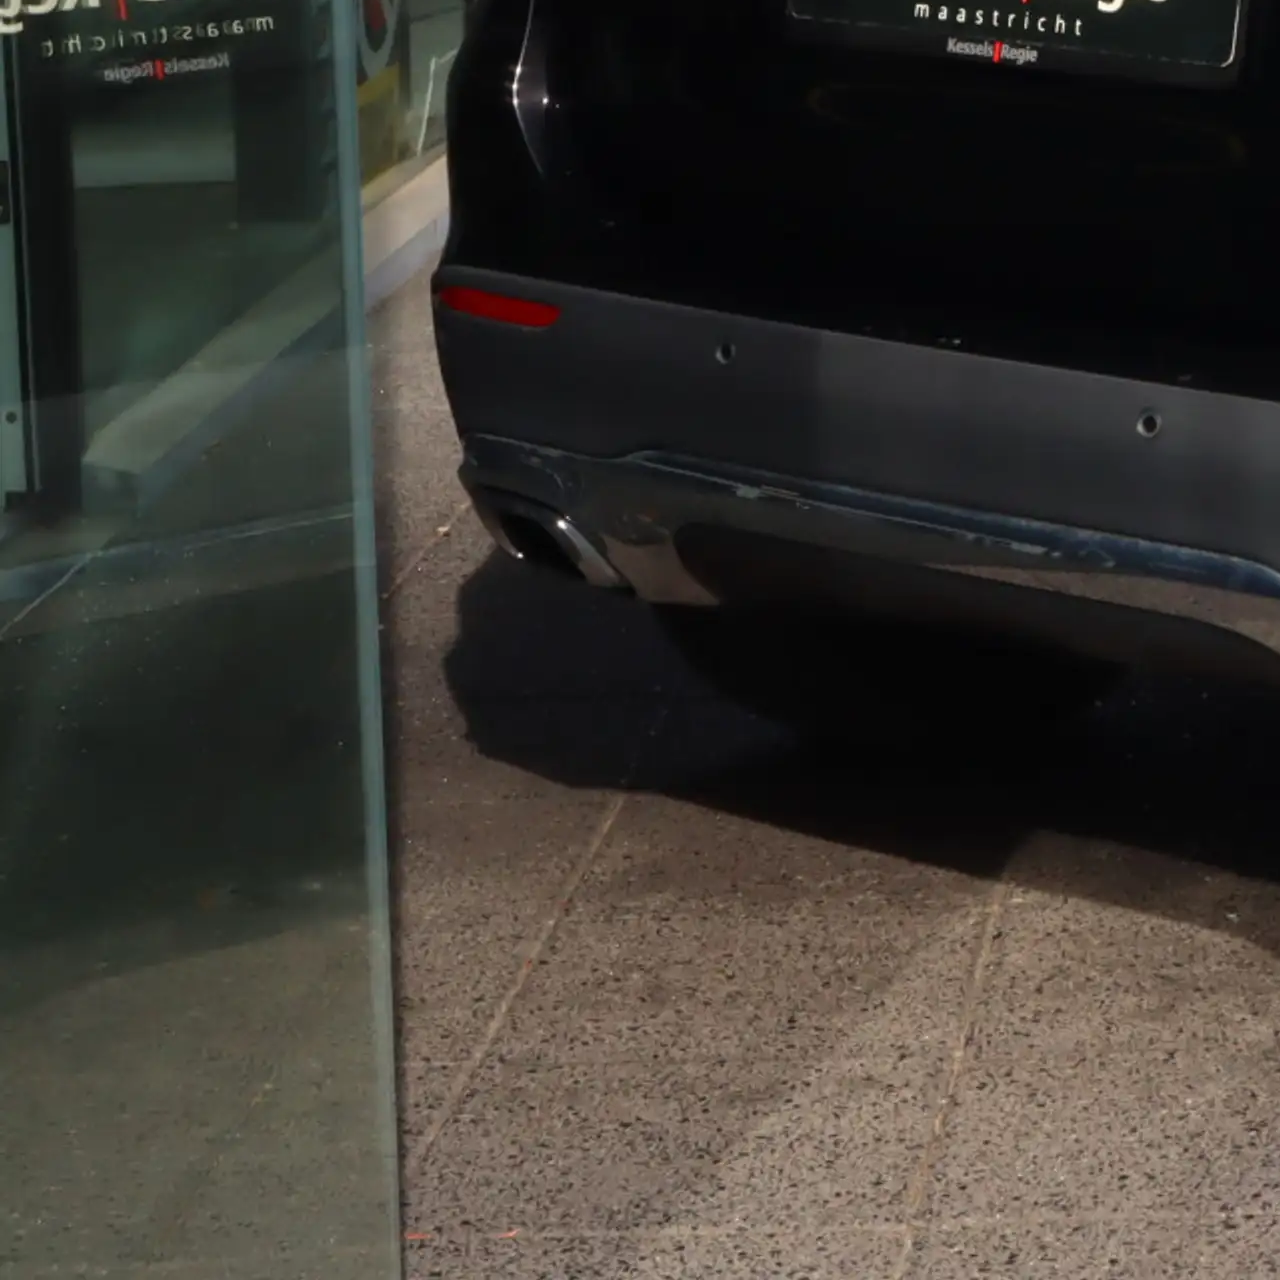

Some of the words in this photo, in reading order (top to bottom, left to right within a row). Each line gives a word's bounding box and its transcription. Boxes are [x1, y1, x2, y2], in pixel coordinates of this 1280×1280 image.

[914, 1, 1083, 36] maastricht
[946, 37, 993, 58] Kessels
[1000, 42, 1038, 65] Regie
